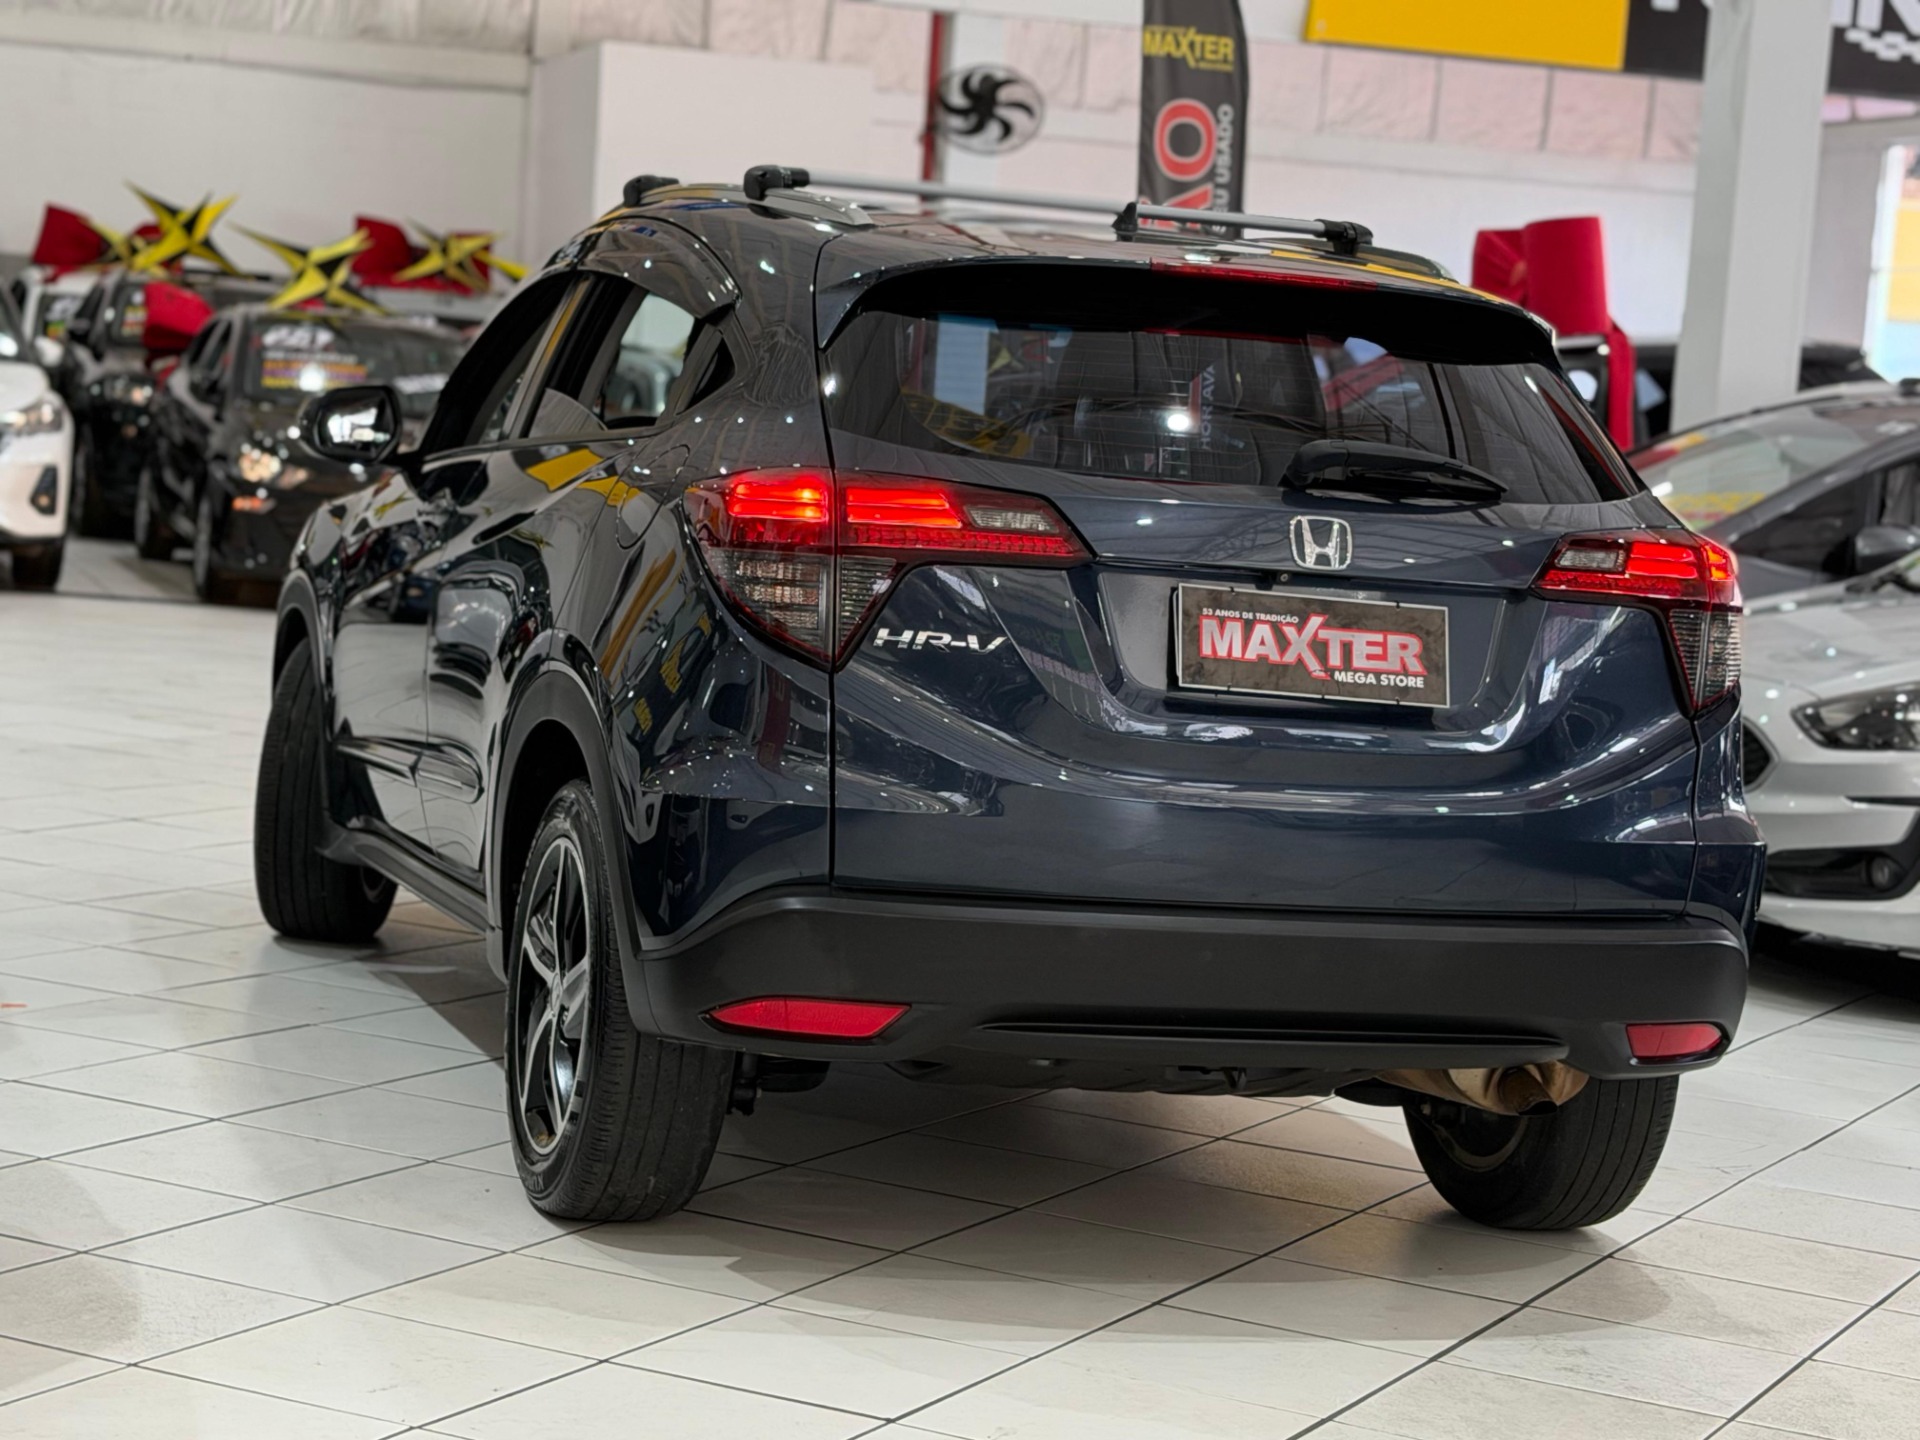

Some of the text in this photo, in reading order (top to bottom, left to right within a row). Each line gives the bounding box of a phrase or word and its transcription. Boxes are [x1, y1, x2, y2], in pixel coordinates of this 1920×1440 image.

[1143, 26, 1235, 69] MAXTER
[1213, 103, 1235, 184] USADO
[1202, 607, 1299, 624] 53 ANOS DE TRADIÇÃO
[873, 627, 1008, 655] HR-V
[1200, 613, 1428, 680] MAXTER
[1334, 670, 1425, 688] MEGA STORE
